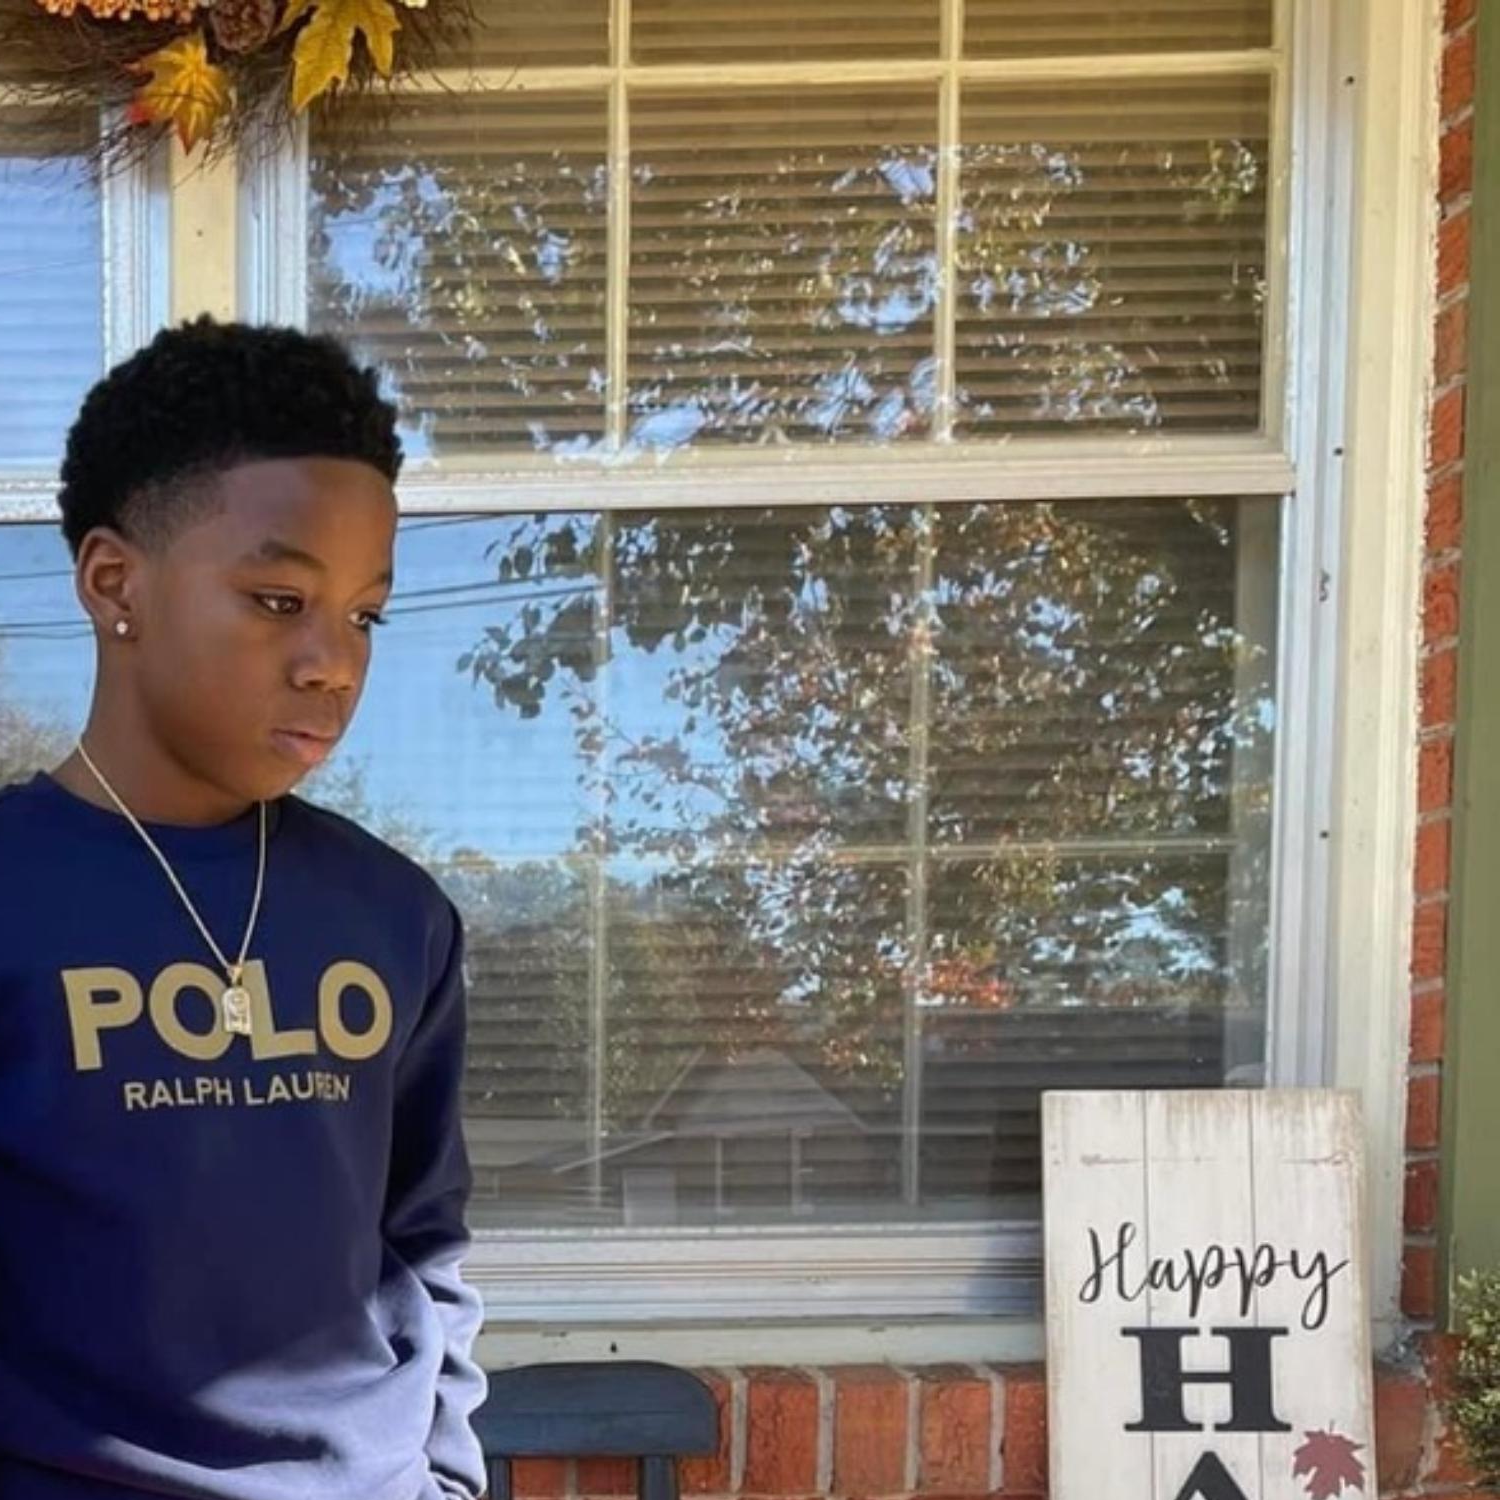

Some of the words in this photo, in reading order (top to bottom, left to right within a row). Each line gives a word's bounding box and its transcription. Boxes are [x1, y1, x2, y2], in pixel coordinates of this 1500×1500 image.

[60, 959, 393, 1072] POLO
[123, 1077, 234, 1111] RALPH
[243, 1072, 352, 1107] LAUREN
[1078, 1220, 1350, 1331] Happy
